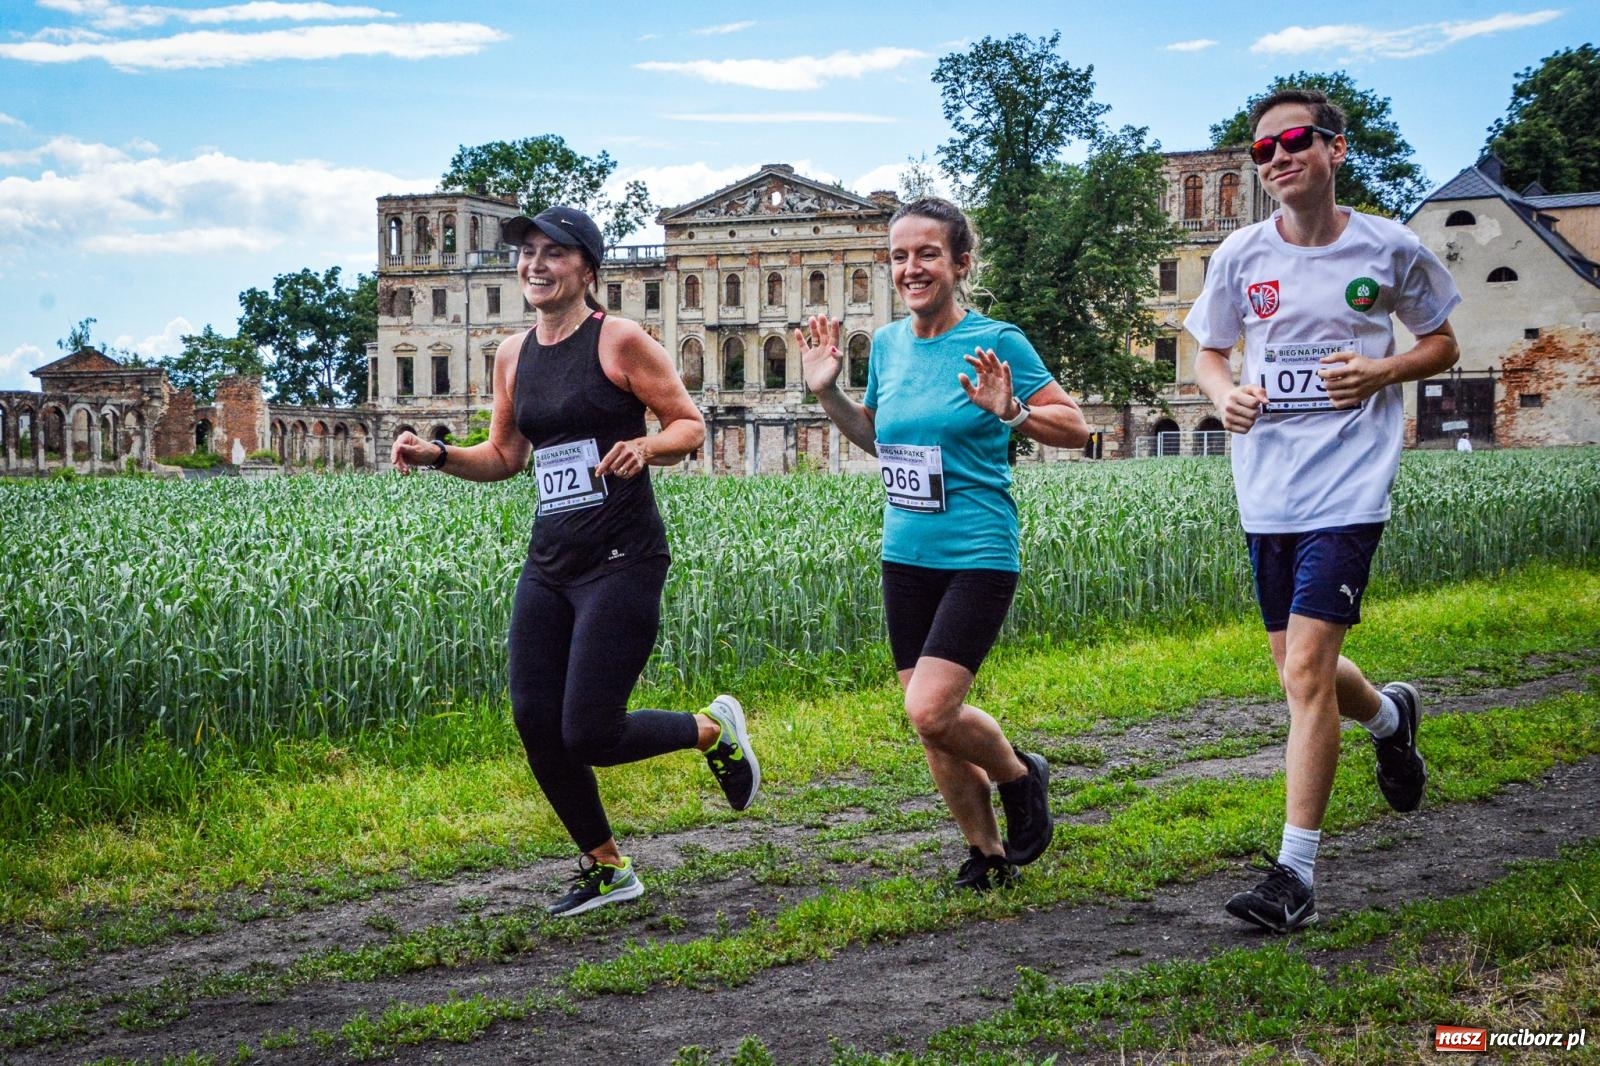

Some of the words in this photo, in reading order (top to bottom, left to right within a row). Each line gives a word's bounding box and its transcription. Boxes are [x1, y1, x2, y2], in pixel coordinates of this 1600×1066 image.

[1298, 348, 1310, 356] NA
[543, 467, 580, 495] 072
[881, 466, 921, 492] 066
